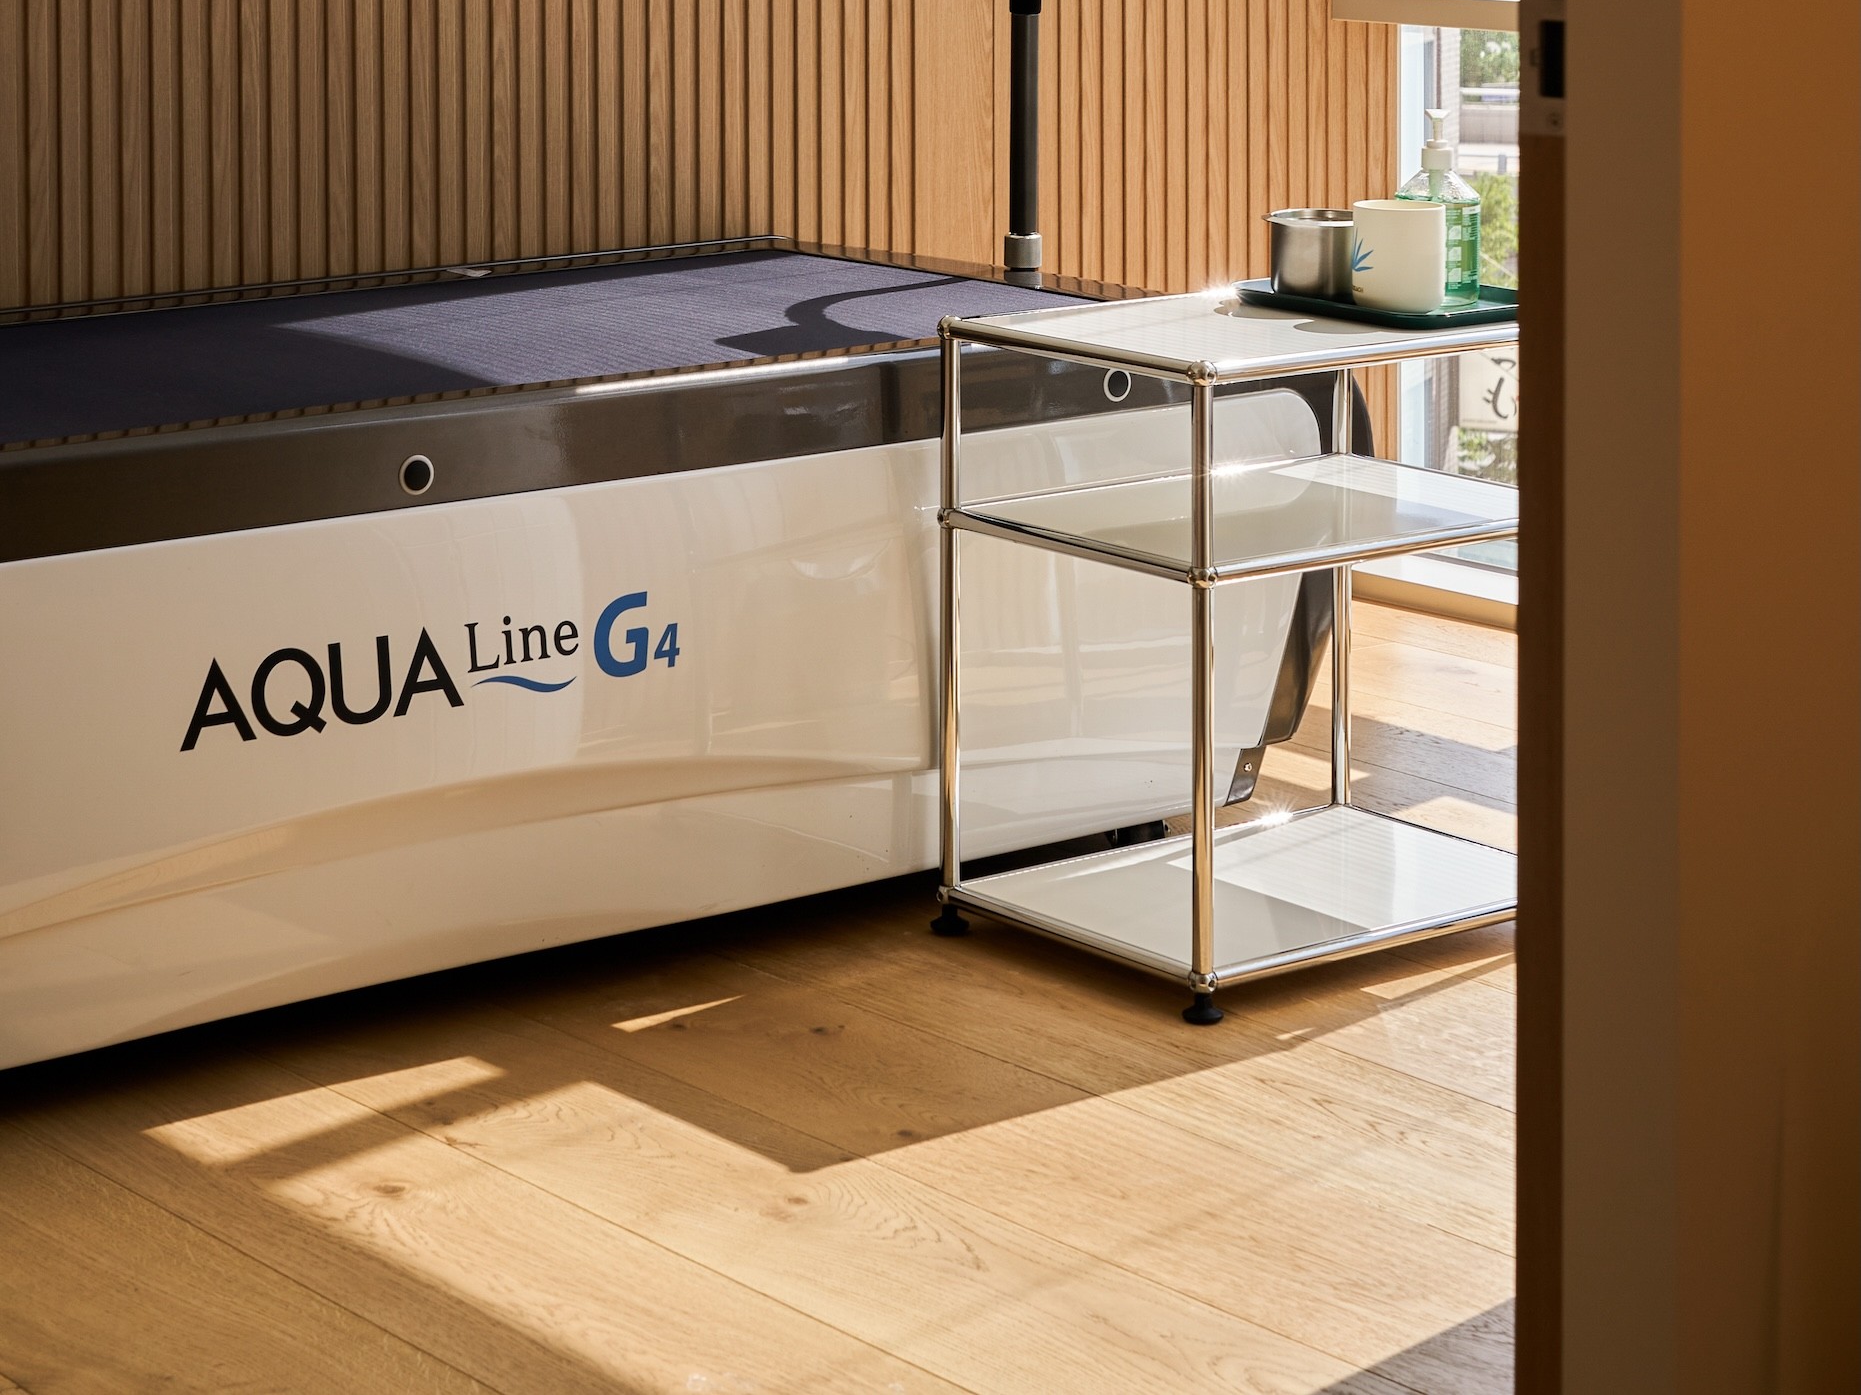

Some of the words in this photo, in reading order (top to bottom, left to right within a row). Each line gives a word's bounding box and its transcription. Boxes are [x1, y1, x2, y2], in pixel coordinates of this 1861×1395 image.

[180, 626, 464, 752] AQUA
[464, 615, 580, 673] Line
[593, 591, 681, 678] G4
